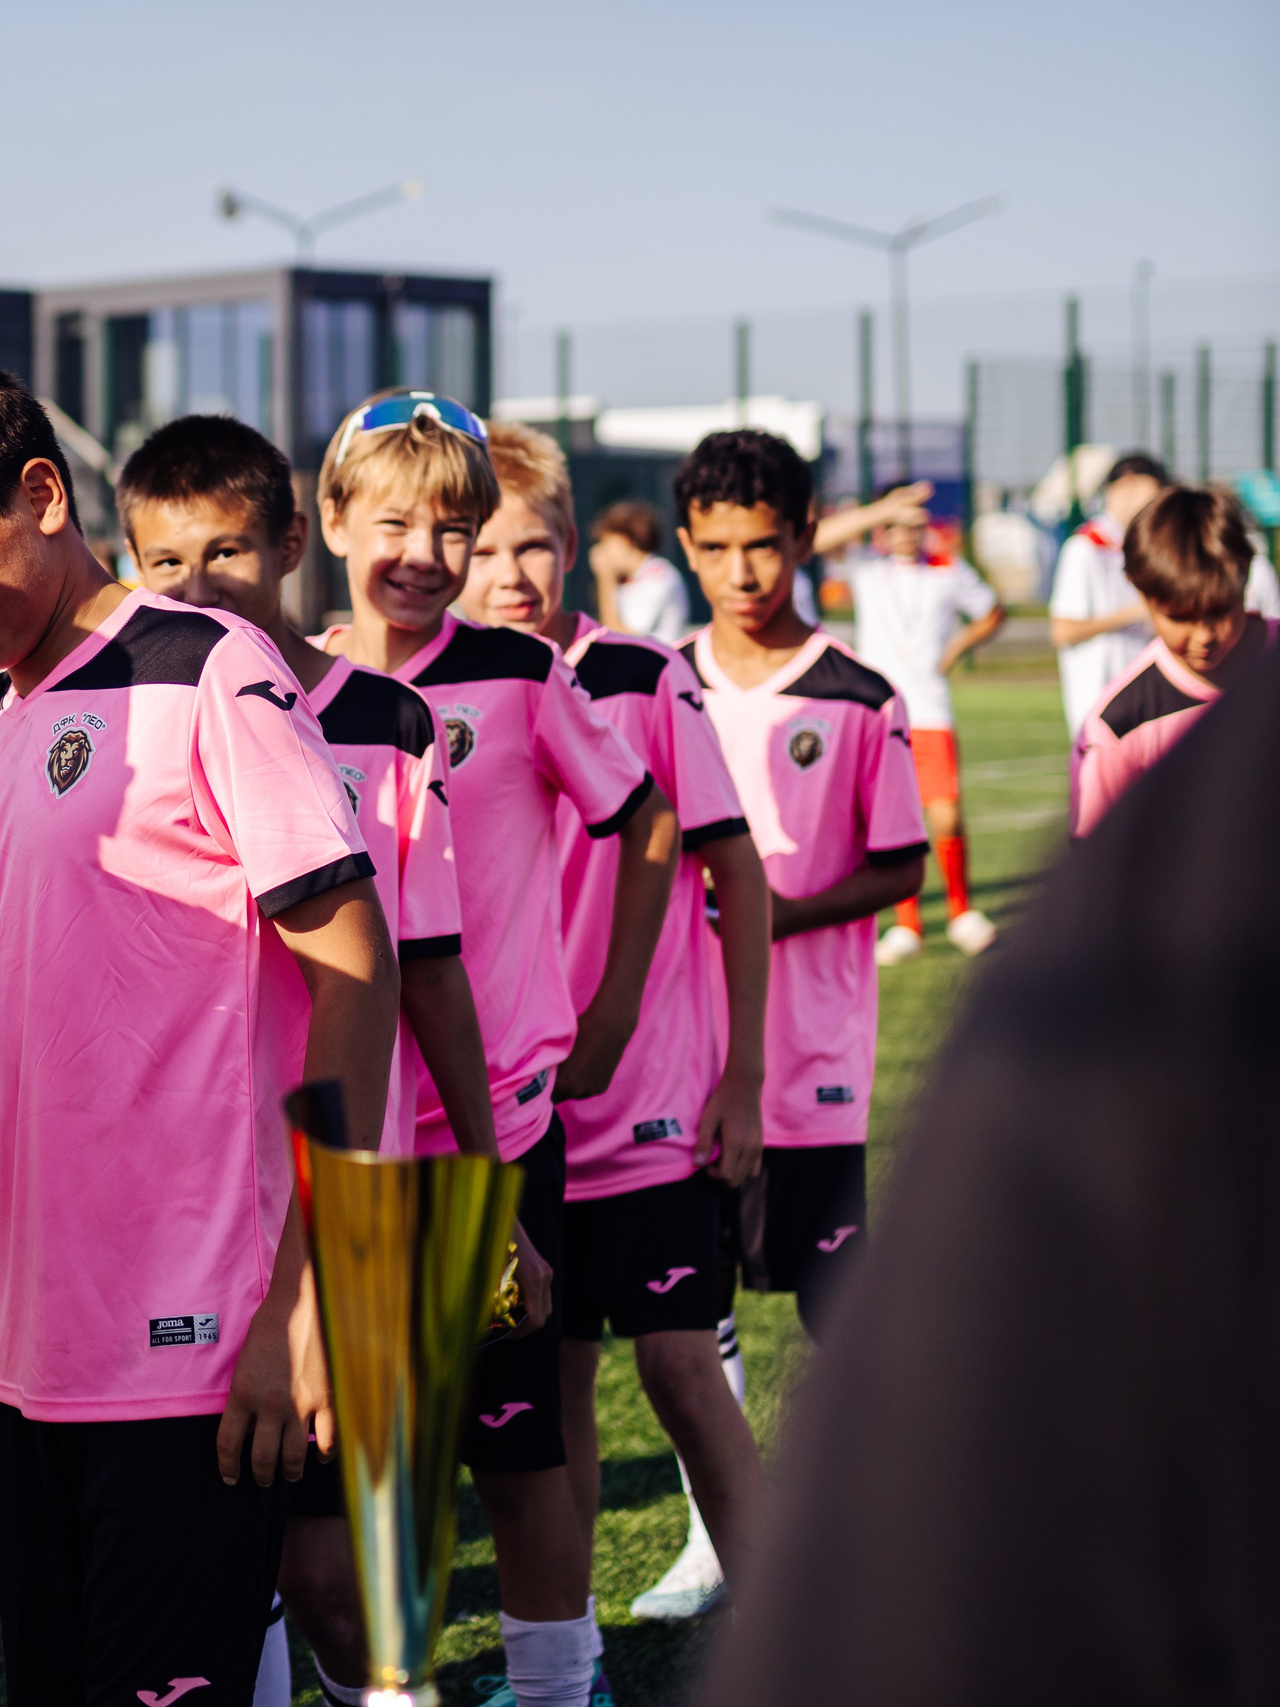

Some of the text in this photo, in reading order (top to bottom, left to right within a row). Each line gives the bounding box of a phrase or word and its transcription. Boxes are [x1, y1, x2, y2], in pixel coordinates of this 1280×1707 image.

[52, 714, 76, 735] ДФК
[162, 1335, 173, 1343] FOR
[174, 1334, 193, 1342] SPORT
[198, 1333, 217, 1341] 1965
